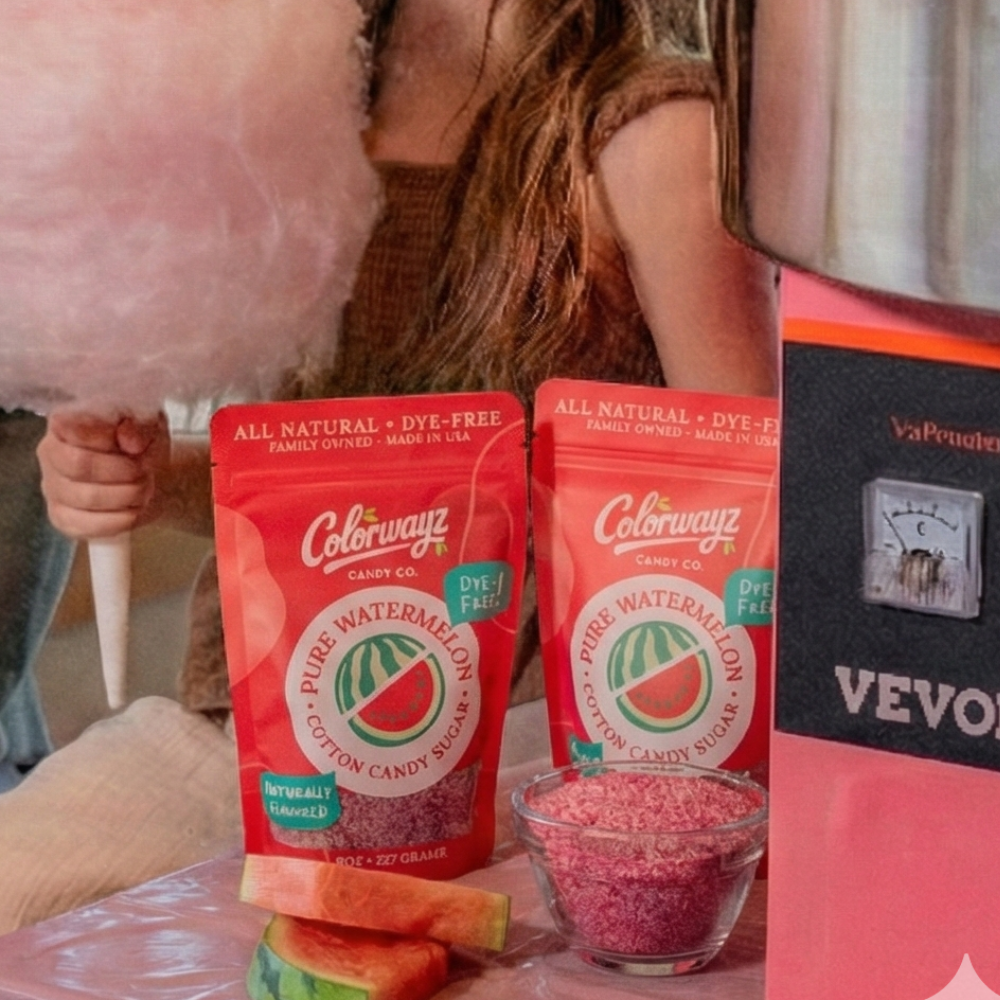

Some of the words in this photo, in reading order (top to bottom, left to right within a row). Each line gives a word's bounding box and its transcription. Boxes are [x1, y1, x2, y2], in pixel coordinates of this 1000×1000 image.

[233, 423, 273, 441] ALL
[281, 417, 378, 438] NATURAL
[402, 410, 502, 432] DYE-FREE
[554, 399, 592, 416] ALL
[598, 401, 690, 424] NATURAL
[586, 419, 630, 433] FAMILY
[635, 423, 682, 438] OWNED
[695, 429, 732, 443] MADE
[736, 432, 751, 445] IN
[269, 439, 318, 453] FAMILY
[322, 436, 372, 450] OWNED
[387, 432, 423, 446] MADE
[427, 432, 441, 443] IN
[301, 504, 449, 567] Colorwayz
[594, 491, 740, 554] Colorwayz
[348, 568, 391, 581] CANDY
[395, 567, 418, 579] CO.
[635, 554, 679, 568] CANDY
[683, 558, 704, 572] CO.
[300, 630, 337, 695] PURE
[334, 601, 473, 682] WATERMELON
[580, 607, 616, 664] PURE
[616, 590, 743, 682] WATERMELON
[306, 714, 364, 773] COTTON
[368, 756, 428, 780] CANDY
[432, 700, 470, 761] SUGAR
[584, 683, 627, 750] COTTON
[630, 746, 690, 764] CANDY
[694, 702, 739, 756] SUGAR
